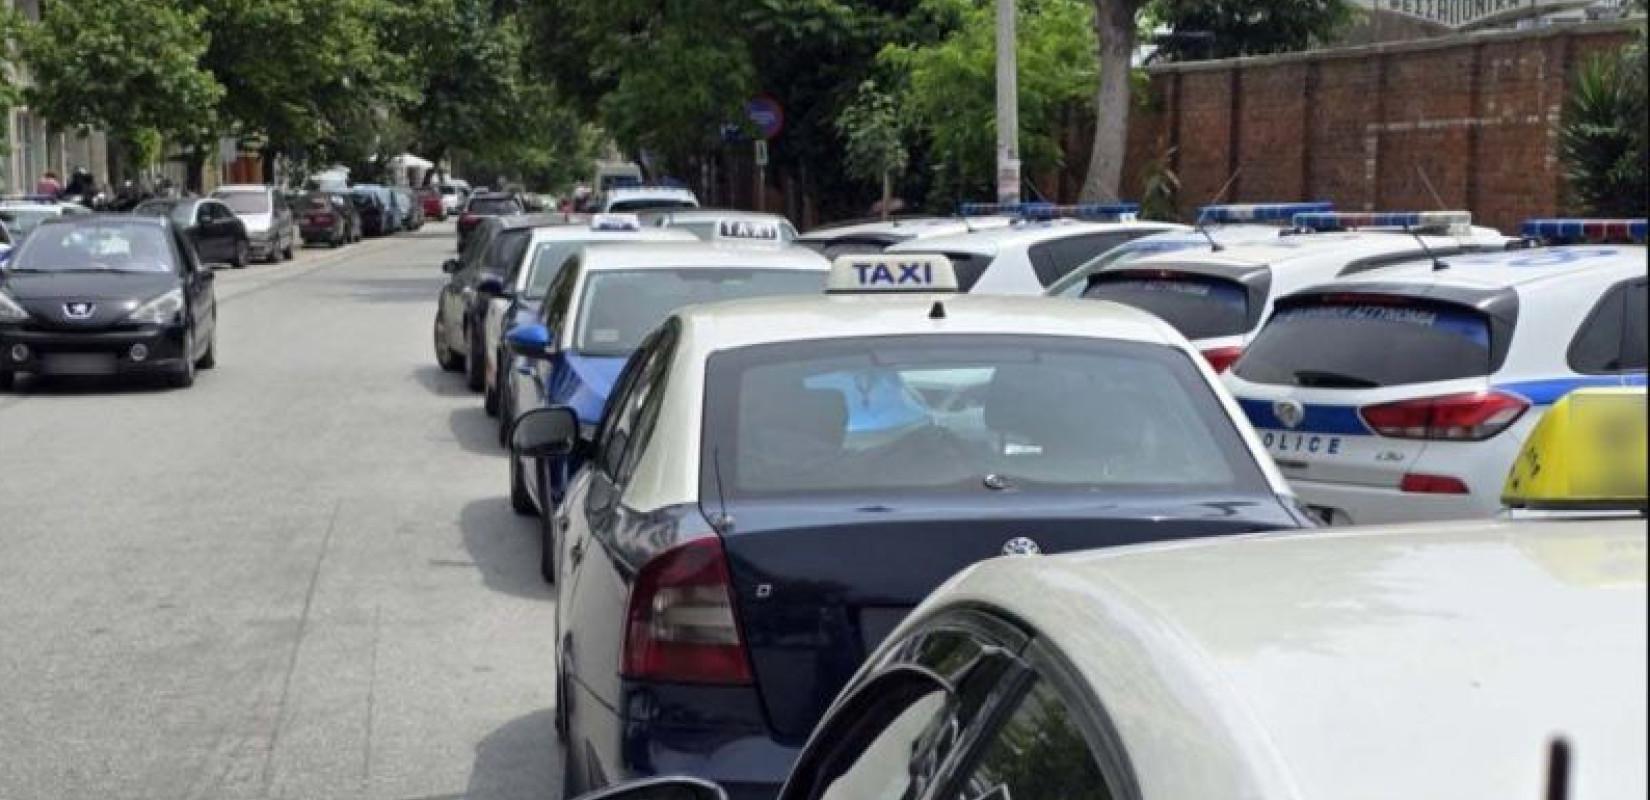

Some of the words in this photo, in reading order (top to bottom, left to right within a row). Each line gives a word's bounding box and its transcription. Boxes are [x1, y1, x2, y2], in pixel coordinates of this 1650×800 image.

[721, 219, 775, 240] TAXI
[852, 262, 932, 285] TAXI
[1263, 432, 1341, 455] OLICE
